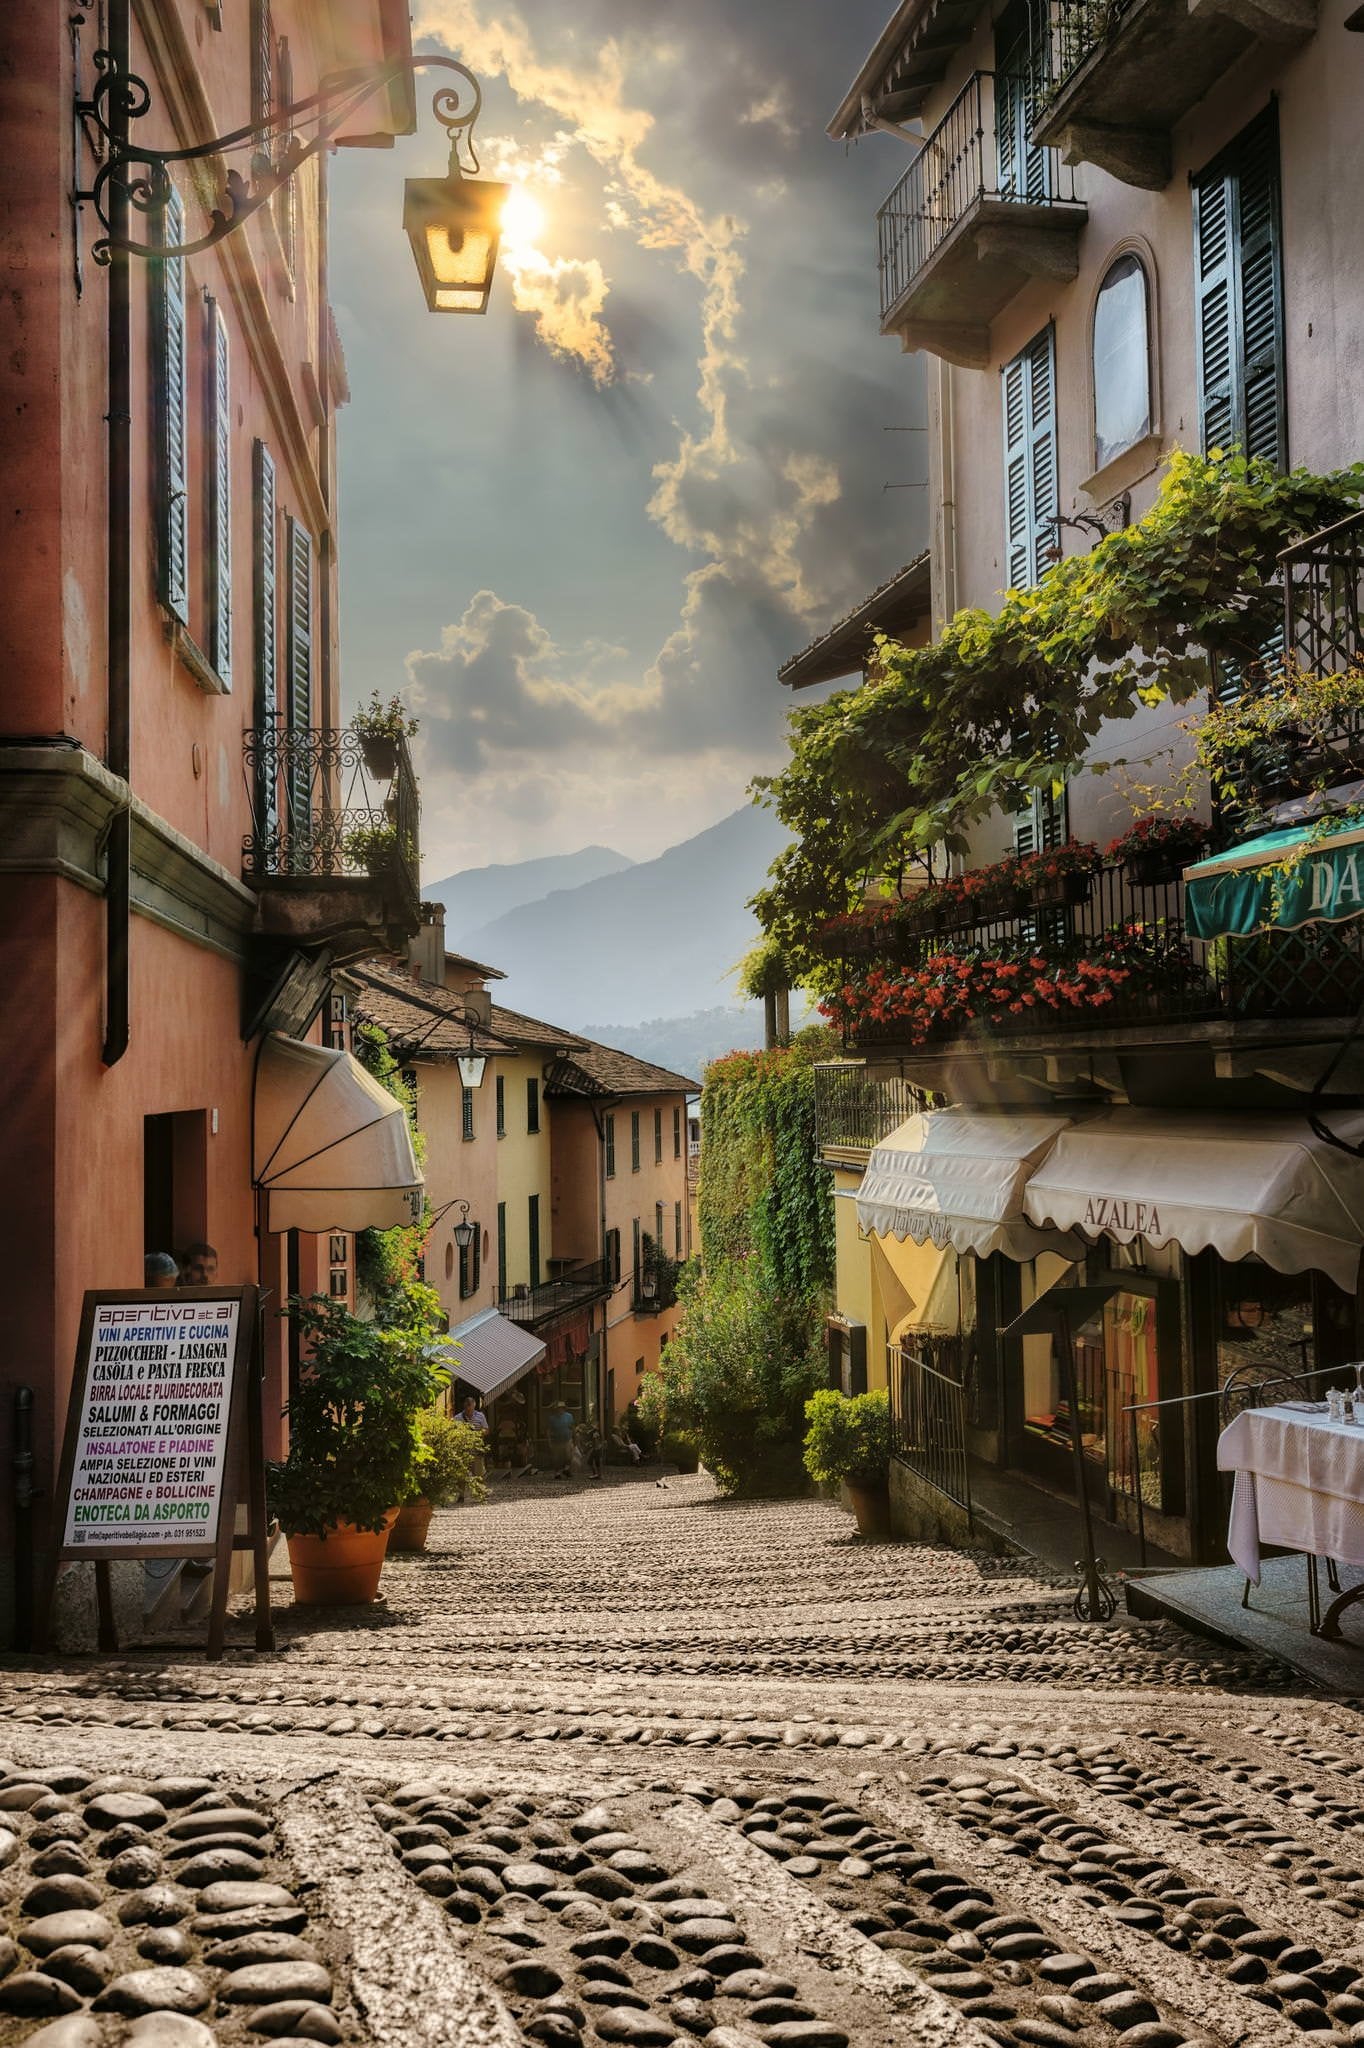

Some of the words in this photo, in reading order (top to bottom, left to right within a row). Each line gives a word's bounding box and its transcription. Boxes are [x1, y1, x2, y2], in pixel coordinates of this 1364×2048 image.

[1084, 1196, 1161, 1236] AZALEA
[893, 1208, 925, 1235] Italian
[928, 1214, 953, 1245] Style
[98, 1328, 120, 1342] VINI
[123, 1326, 176, 1341] APERITIVI
[179, 1327, 185, 1338] E
[188, 1324, 228, 1338] CUCINA
[95, 1345, 167, 1362] PIZZOCCHERI
[179, 1343, 227, 1359] LASAGNA
[93, 1363, 133, 1381] CASÖLA
[147, 1363, 181, 1379] PASTA
[185, 1362, 225, 1378] FRESCA
[90, 1386, 115, 1401] BIRRA
[118, 1384, 152, 1401] LOCALE
[153, 1382, 223, 1400] PLURIDECORATA
[88, 1406, 135, 1423] SALUMI
[140, 1406, 148, 1420] &
[153, 1404, 219, 1421] FORMAGGI
[83, 1425, 151, 1438] SELEZIONATI
[86, 1441, 155, 1455] INSALATONE
[159, 1441, 166, 1452] E
[169, 1439, 214, 1453] PIADINE
[79, 1459, 113, 1471] AMPIA
[117, 1458, 176, 1469] SELEZIONE
[180, 1458, 190, 1468] DI
[194, 1457, 216, 1467] VINI
[88, 1473, 145, 1484] NAZIONALI
[150, 1472, 163, 1483] ED
[166, 1471, 204, 1482] ESTERI
[74, 1488, 142, 1501] CHAMPAGNE
[156, 1486, 215, 1499] BOLLICINE
[74, 1504, 130, 1522] ENOTECA
[134, 1504, 150, 1520] DA
[153, 1502, 209, 1519] ASPORTO
